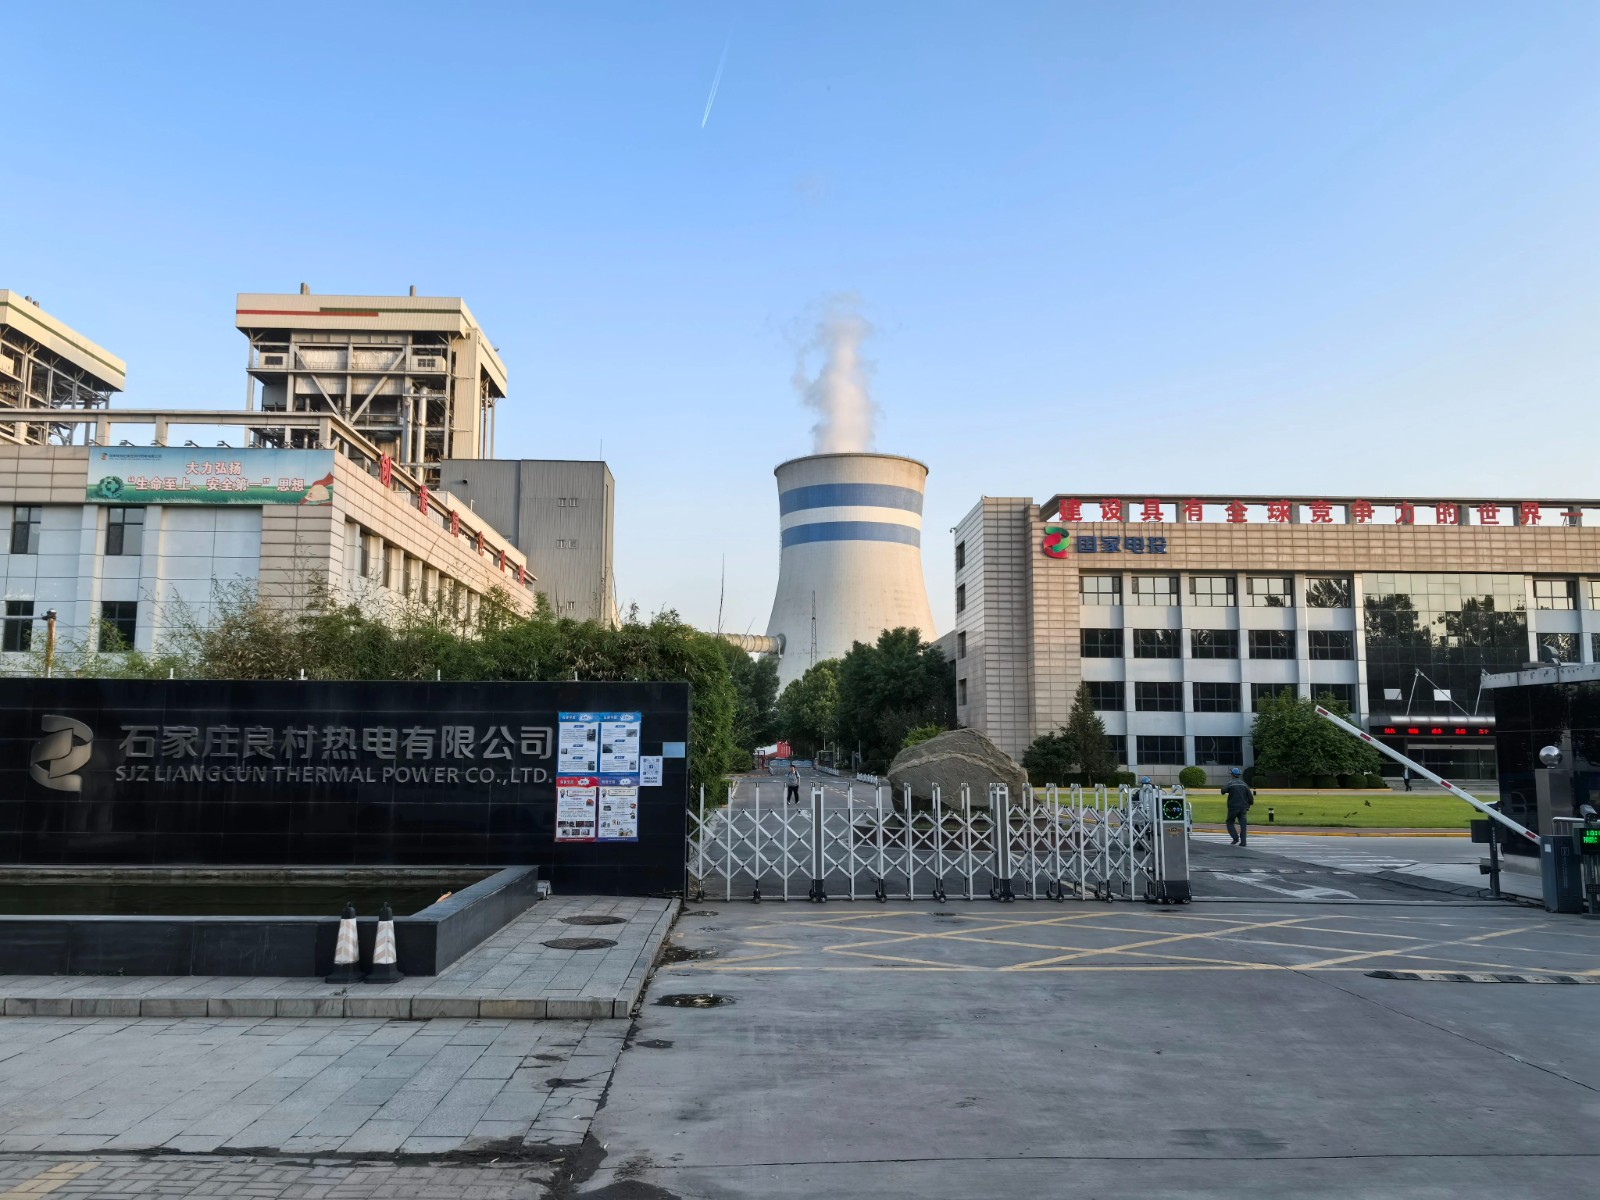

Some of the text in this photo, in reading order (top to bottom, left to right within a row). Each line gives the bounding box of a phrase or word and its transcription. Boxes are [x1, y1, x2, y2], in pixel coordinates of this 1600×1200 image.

[185, 461, 242, 475] 大力弘扬
[1058, 498, 1583, 525] 建设具有全球竞争力的世界一
[1077, 536, 1167, 554] 国家电投
[118, 725, 553, 760] 石家庄良村热电有限公司
[115, 765, 150, 782] SJZ
[154, 765, 268, 783] LIANGCUN
[273, 766, 376, 783] THERMAL
[382, 767, 460, 784] POWER
